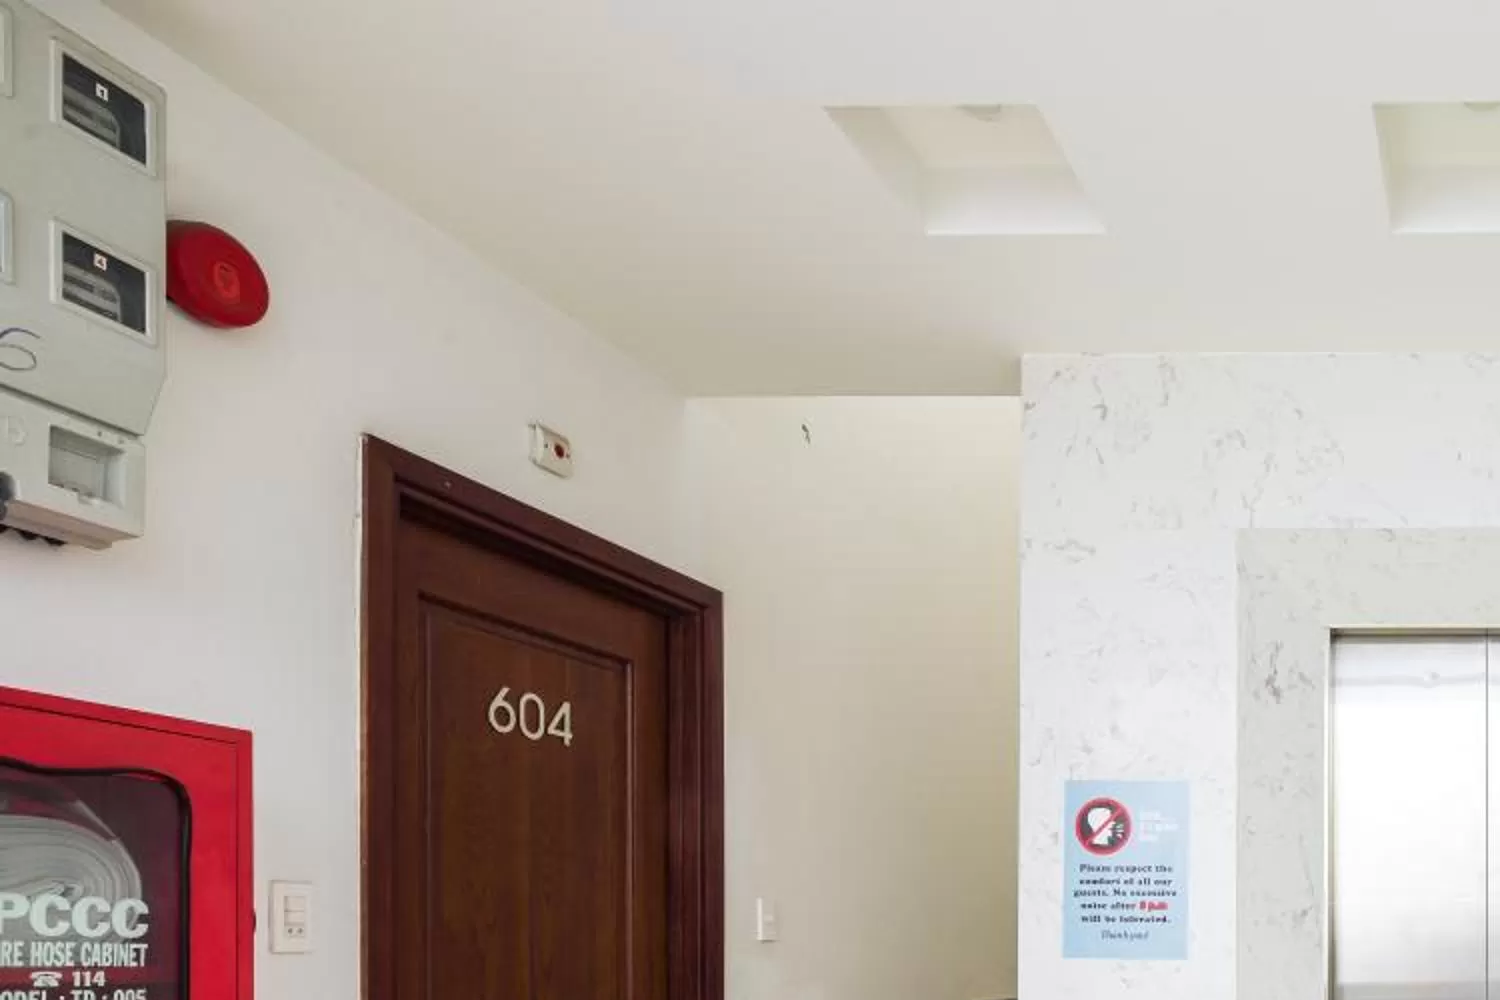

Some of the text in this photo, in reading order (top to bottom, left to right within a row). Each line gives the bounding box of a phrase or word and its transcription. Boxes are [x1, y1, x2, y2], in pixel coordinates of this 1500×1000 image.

[488, 687, 573, 747] 604
[1079, 863, 1173, 874] Please respect the
[1138, 877, 1151, 885] all
[0, 891, 149, 939] PCCC
[1081, 915, 1101, 923] will
[30, 941, 76, 967] HOSE
[80, 942, 149, 967] CABINET
[72, 970, 105, 987] 114
